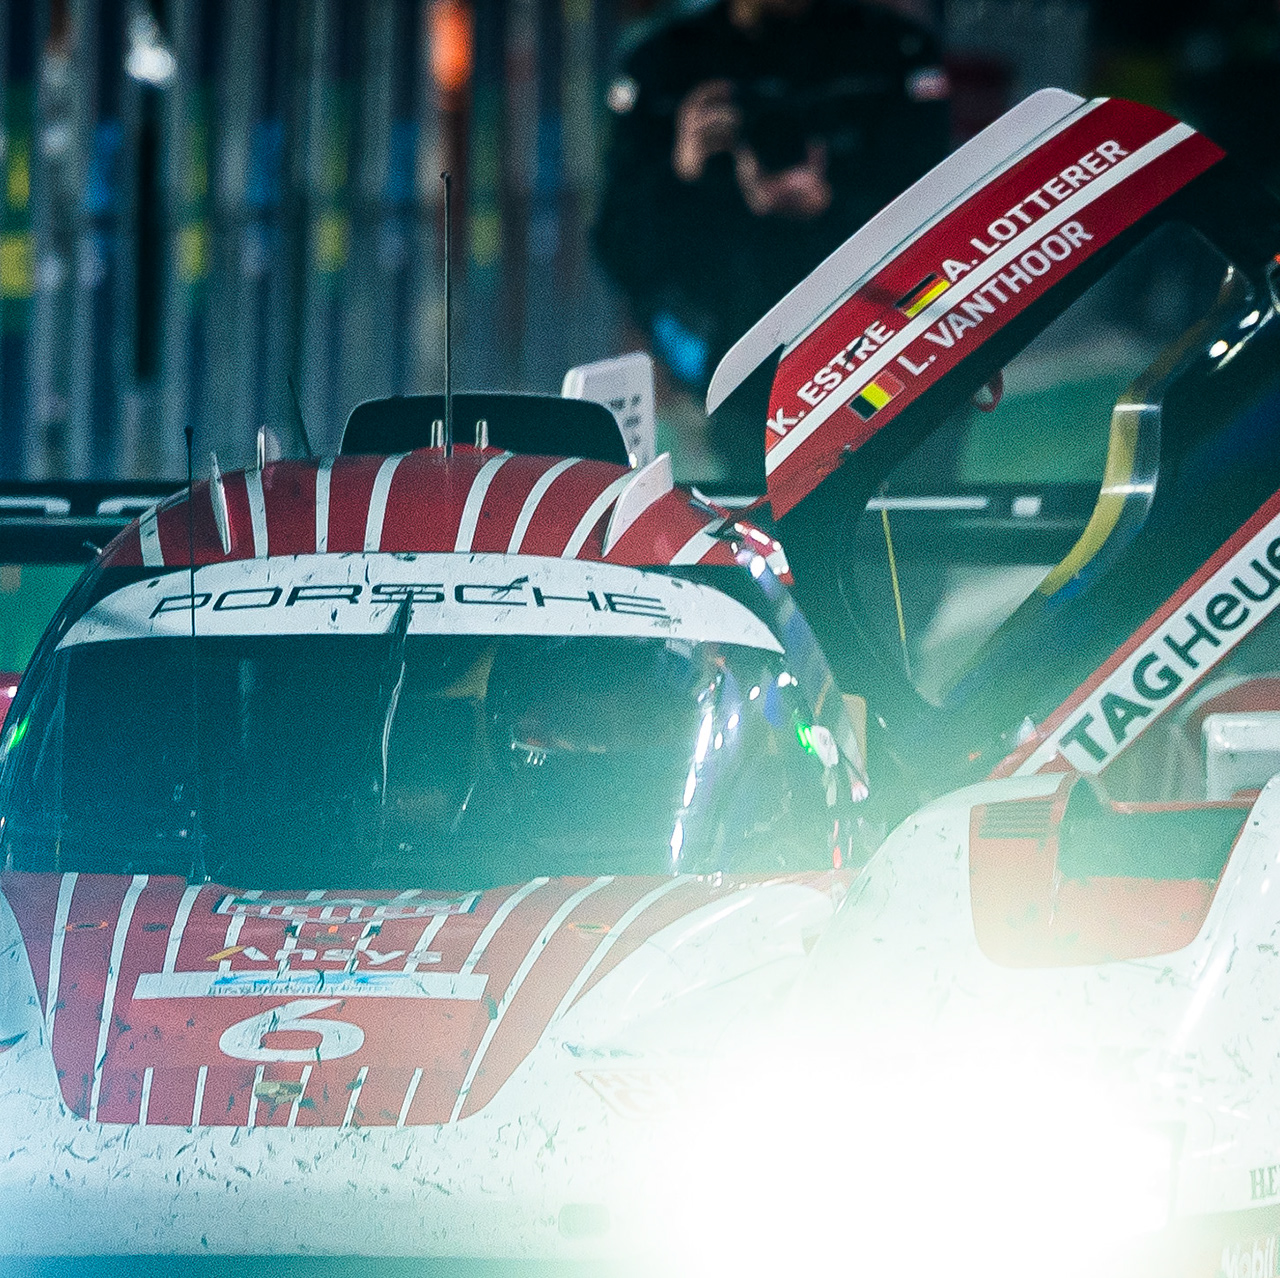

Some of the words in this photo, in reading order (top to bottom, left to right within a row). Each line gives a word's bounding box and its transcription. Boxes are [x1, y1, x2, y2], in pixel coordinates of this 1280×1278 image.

[941, 259, 978, 282] A.
[970, 139, 1128, 255] LOTTERER
[897, 354, 937, 376] L.
[924, 220, 1094, 348] VANTHOOR
[766, 408, 805, 436] K.
[797, 320, 894, 406] ESTRE
[148, 583, 671, 619] PORSCHE
[219, 998, 366, 1062] 6
